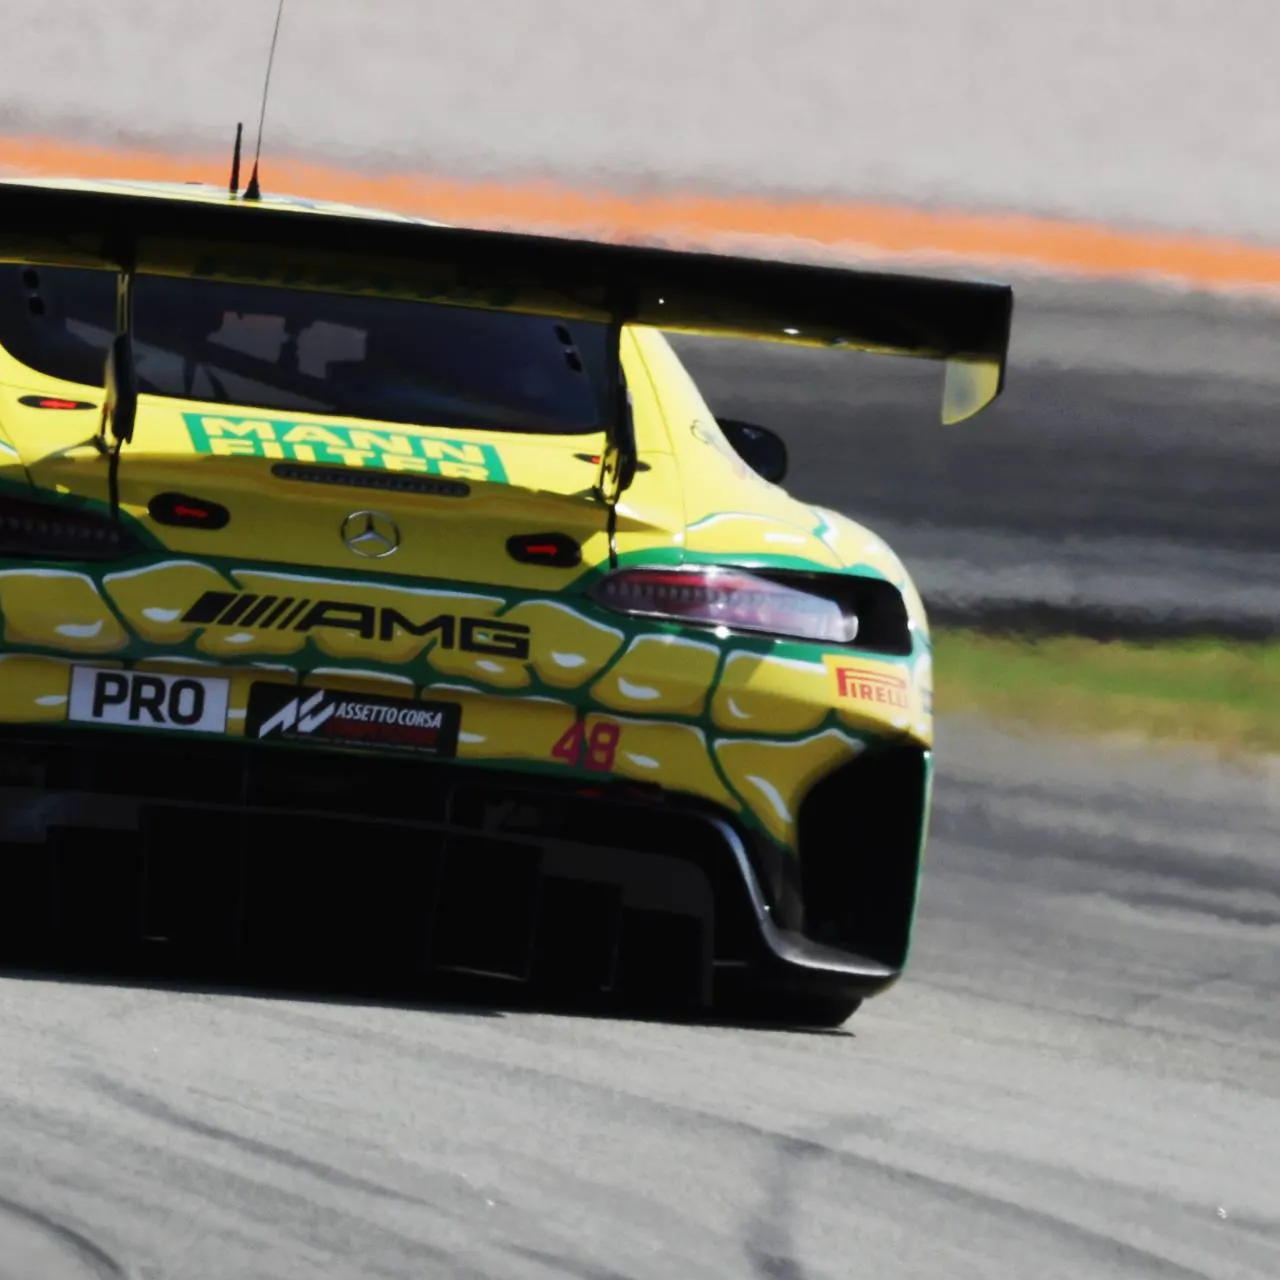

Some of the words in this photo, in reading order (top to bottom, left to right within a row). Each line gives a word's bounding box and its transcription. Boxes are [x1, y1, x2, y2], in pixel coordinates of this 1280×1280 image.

[201, 416, 486, 464] MANN
[293, 600, 531, 660] AMG
[92, 671, 206, 726] PRO
[836, 666, 908, 708] PIRELLI
[335, 701, 397, 725] ASSETTO
[398, 709, 443, 729] CORSA
[550, 719, 621, 773] 48
